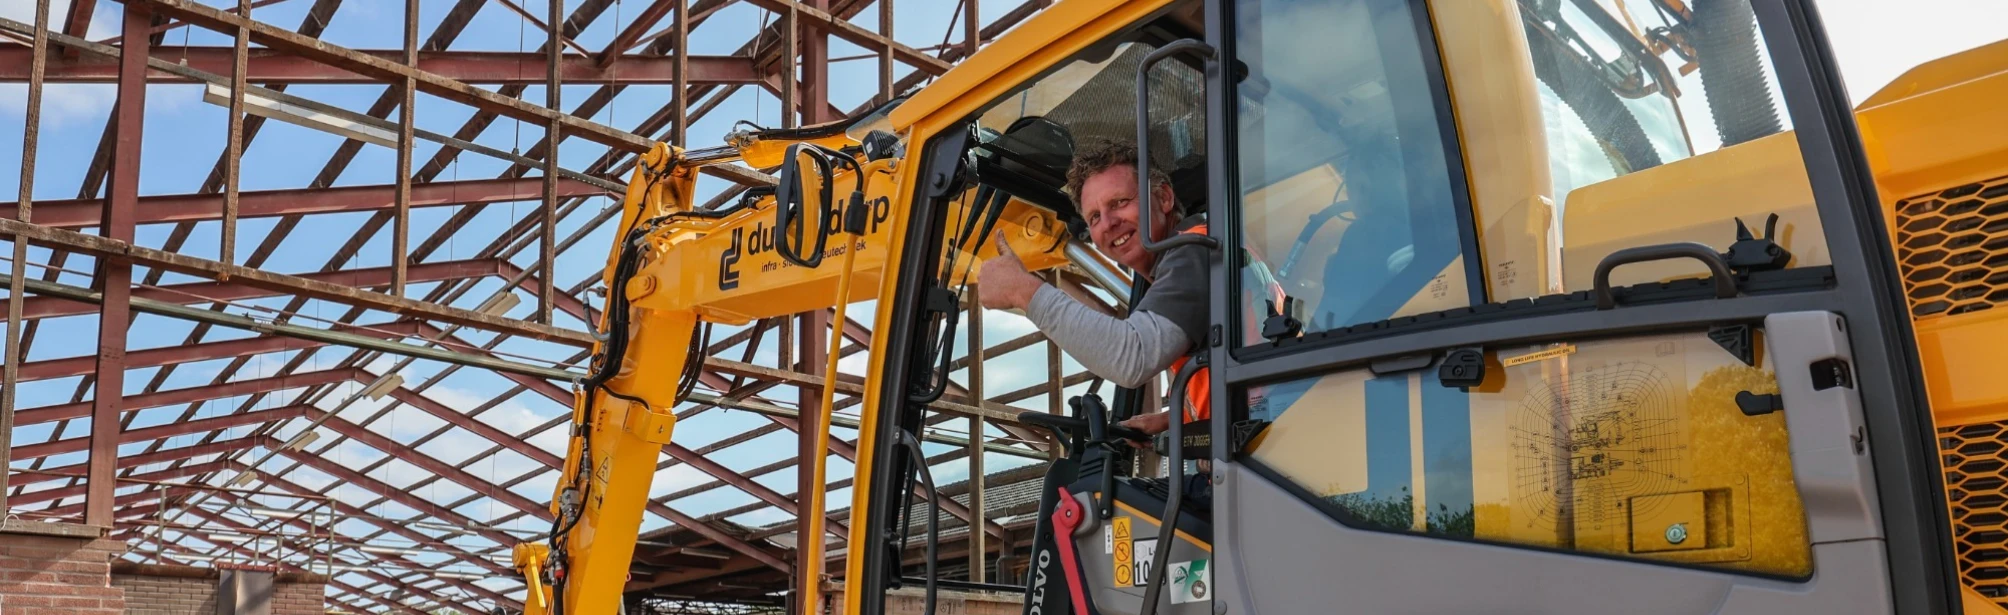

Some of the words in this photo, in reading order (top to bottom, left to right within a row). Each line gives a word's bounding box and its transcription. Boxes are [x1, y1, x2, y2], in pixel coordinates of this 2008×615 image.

[761, 260, 777, 273] infra
[1029, 549, 1051, 615] OLVO
[1134, 560, 1152, 583] 10
